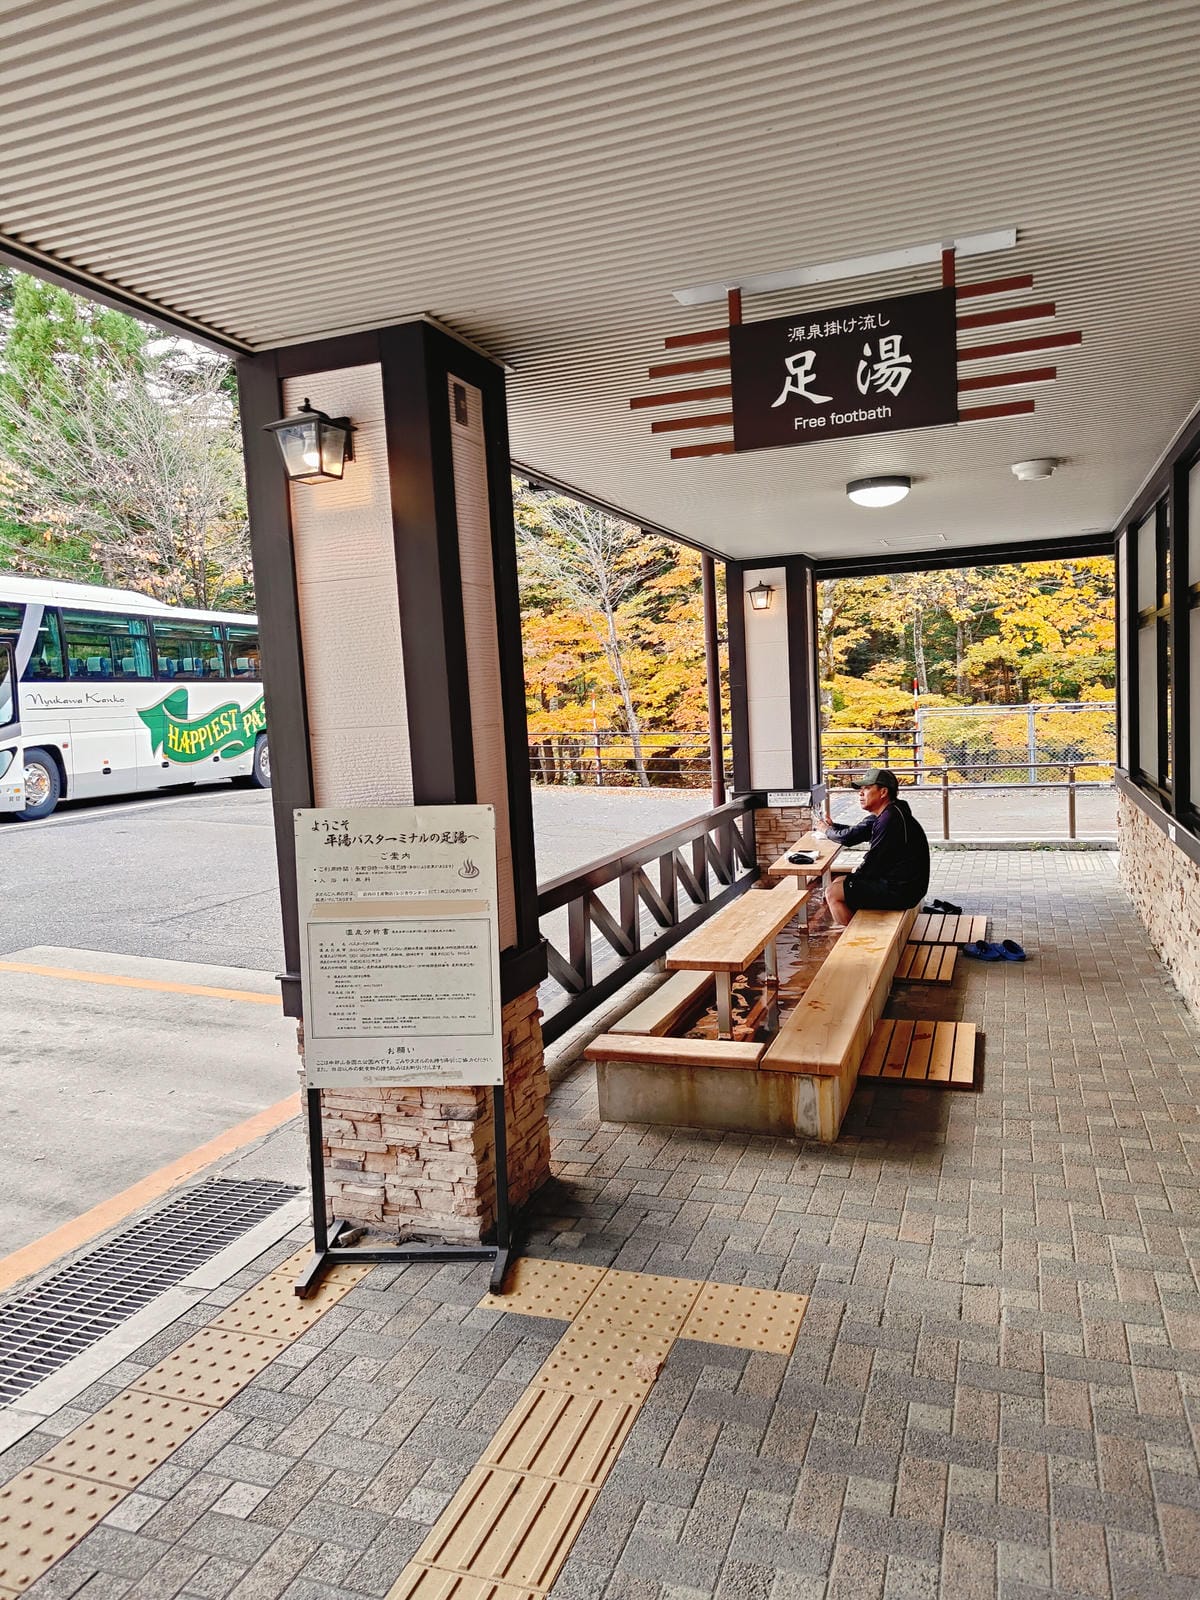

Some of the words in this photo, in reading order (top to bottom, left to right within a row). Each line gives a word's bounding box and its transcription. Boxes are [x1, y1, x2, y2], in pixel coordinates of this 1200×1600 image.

[787, 312, 891, 343] 源泉掛け流し
[770, 334, 913, 408] 足湯
[794, 415, 826, 430] Free
[830, 405, 892, 425] footbath
[85, 692, 126, 704] Kanko
[168, 709, 238, 754] HAPPIEST
[311, 819, 350, 832] ようこそ
[324, 831, 479, 848] 平湯バスターミナルの足湯へ
[379, 851, 411, 861] ご案内
[387, 1046, 415, 1055] お願い
